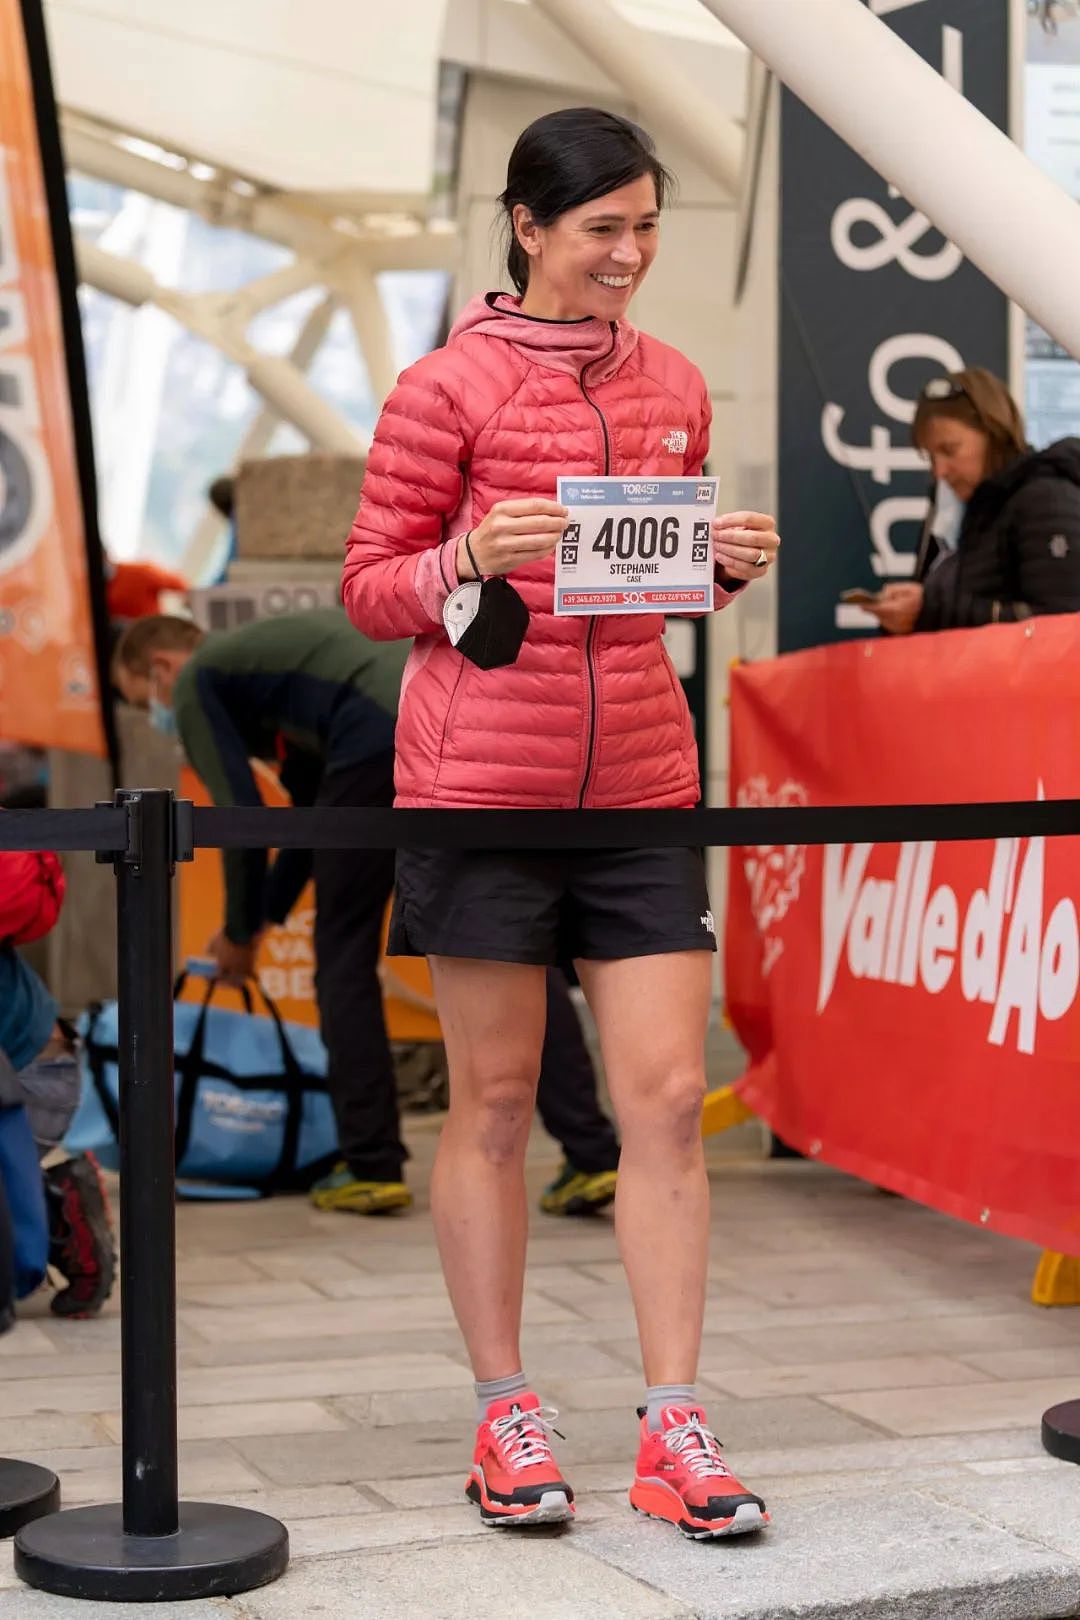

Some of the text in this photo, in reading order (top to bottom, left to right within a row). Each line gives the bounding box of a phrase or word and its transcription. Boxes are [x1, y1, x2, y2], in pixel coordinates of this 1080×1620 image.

[592, 516, 680, 560] 4006
[610, 563, 660, 575] STEPHANIE
[623, 591, 646, 605] SOS
[816, 840, 958, 1016] Valle
